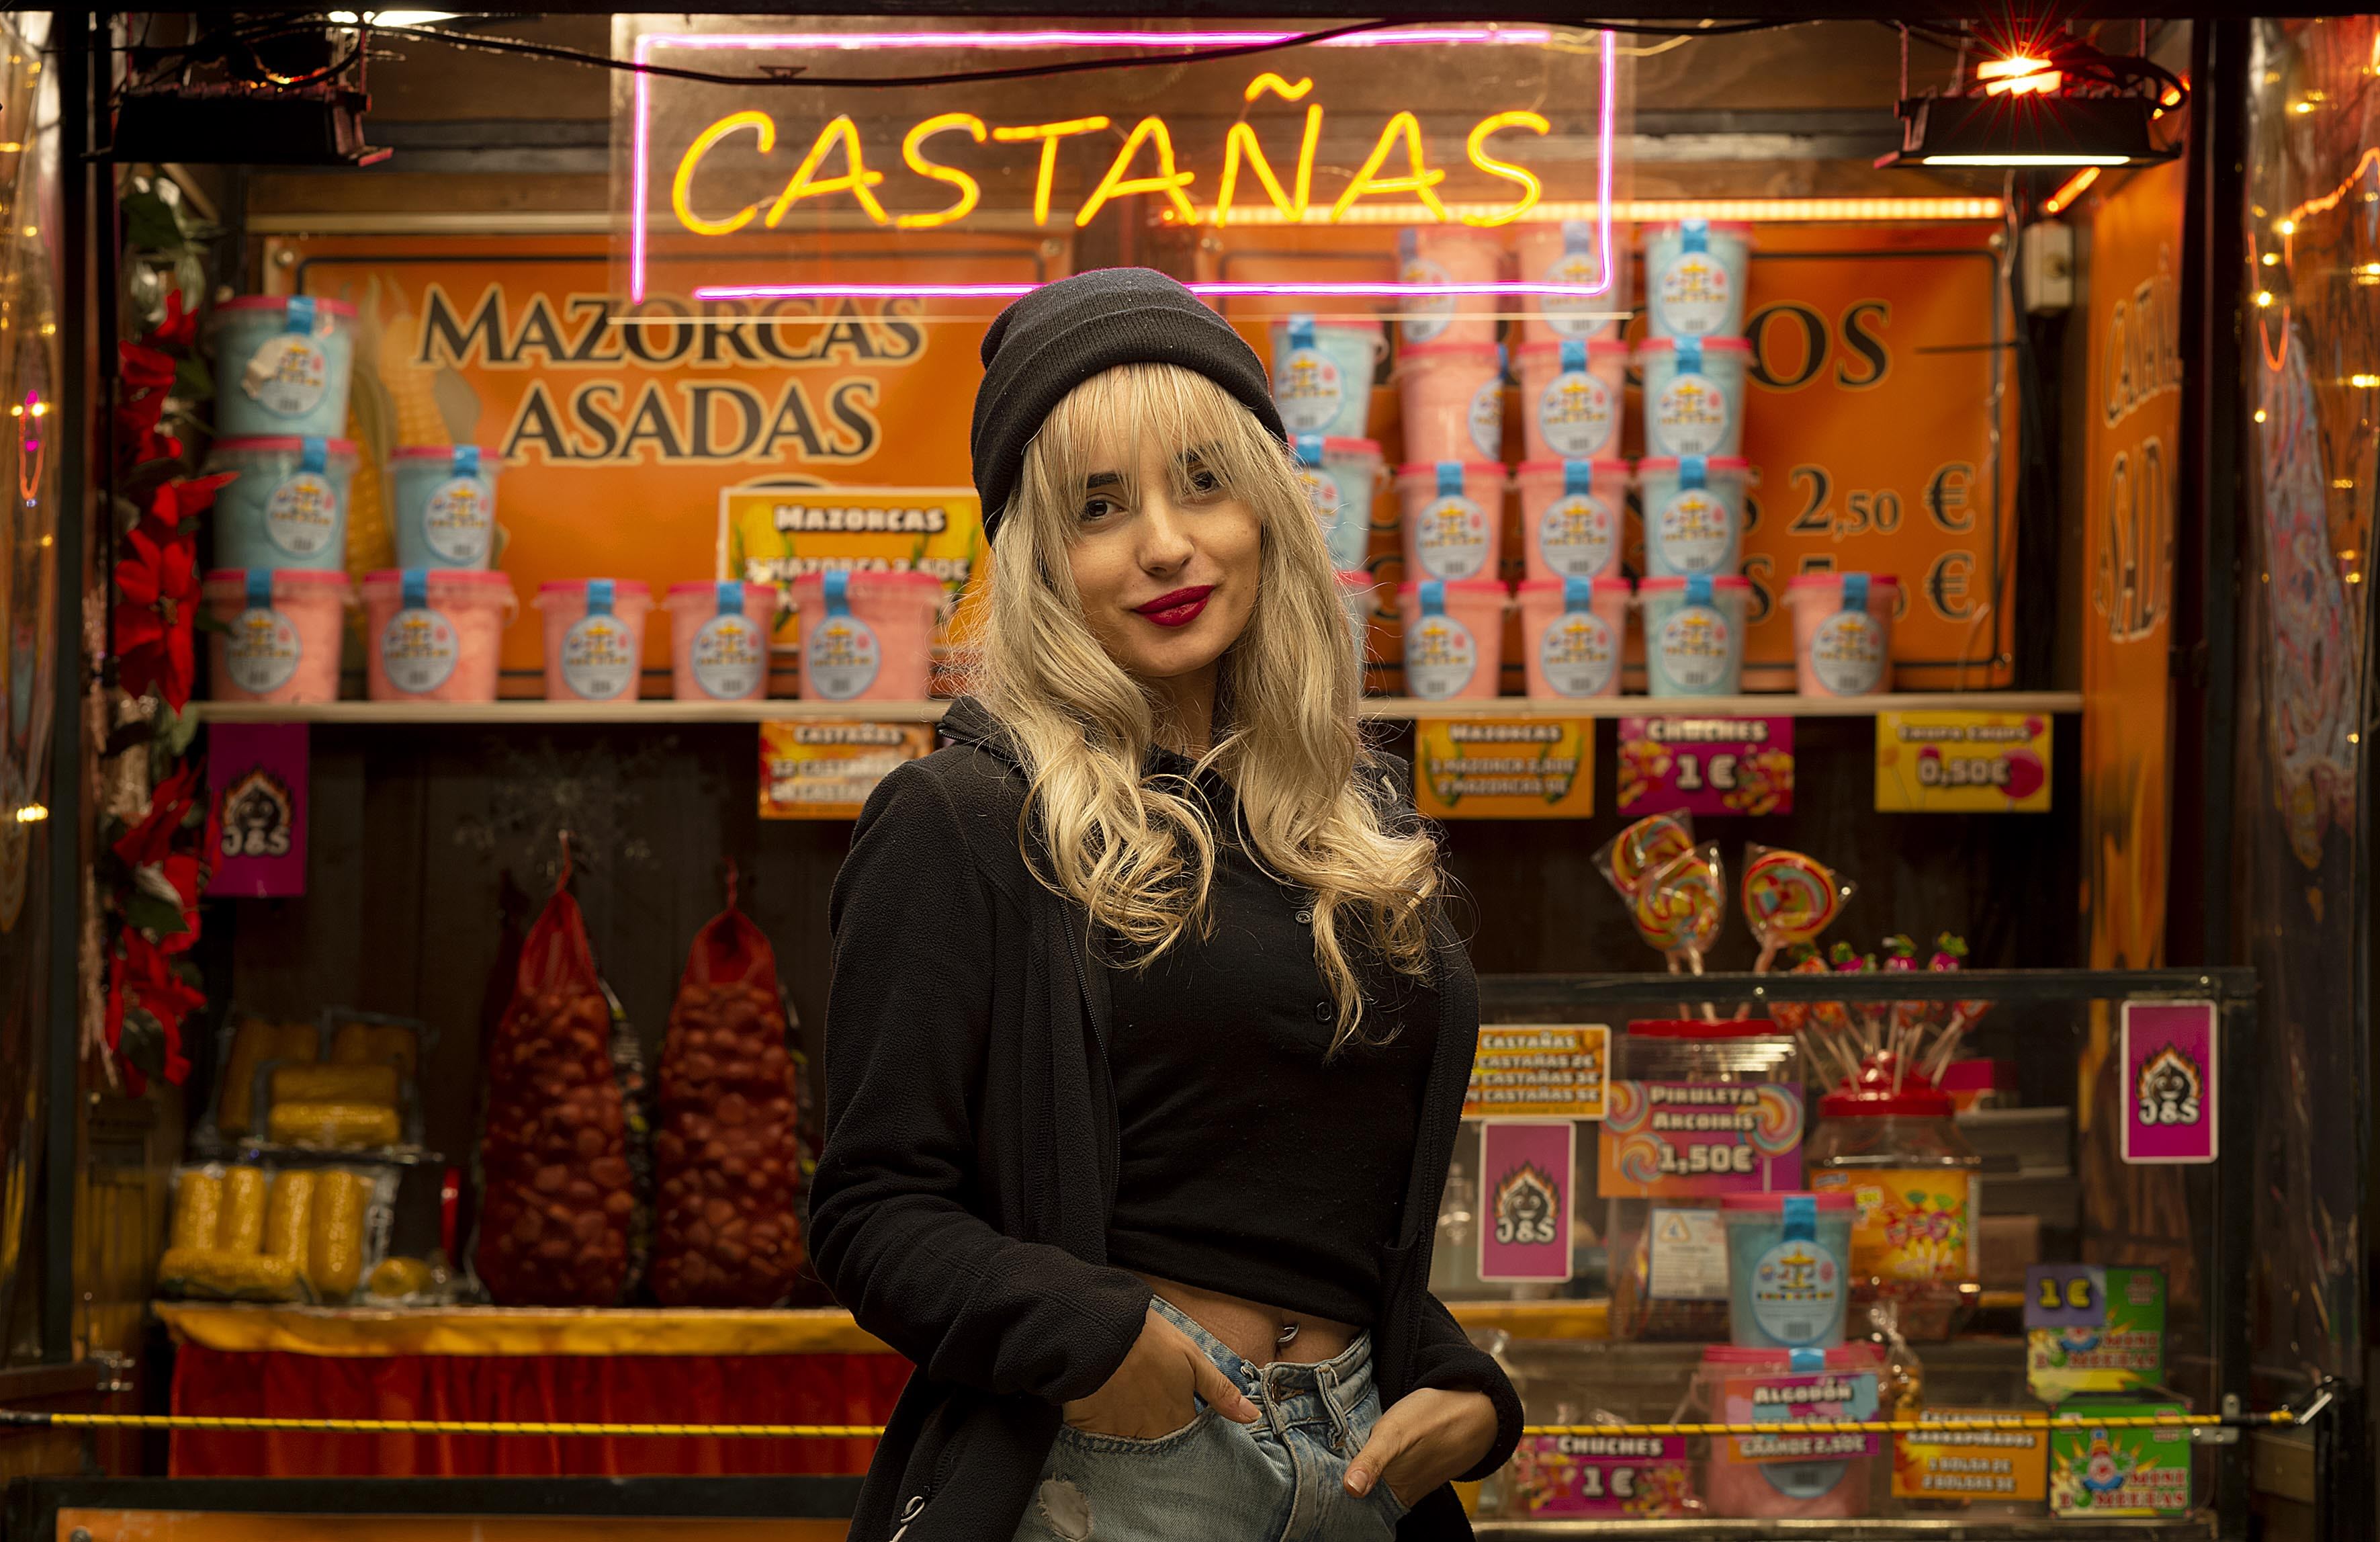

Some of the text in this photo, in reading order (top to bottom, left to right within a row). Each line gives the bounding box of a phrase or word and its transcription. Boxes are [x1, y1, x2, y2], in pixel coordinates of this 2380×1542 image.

[670, 72, 1551, 237] CASTAÑAS
[415, 282, 928, 370] MAZORCAS
[500, 378, 883, 465] ASADAS
[1921, 460, 1976, 535] €
[775, 504, 946, 533] MAZORCAS
[1922, 550, 1976, 624] €
[1449, 723, 1563, 742] MAZORCAS
[1647, 719, 1768, 743] CHUCHES
[1919, 758, 2011, 789] 0,50€
[221, 825, 291, 857] J&S
[1480, 1029, 1577, 1050] CASTAÑAS
[1478, 1053, 1570, 1069] CASTAÑAS
[1481, 1069, 1574, 1086] CASTAÑAS
[1482, 1086, 1575, 1103] CASTAÑAS
[1649, 1085, 1758, 1105] PIRULETA
[1652, 1111, 1755, 1131] ARCOIRIS
[2138, 1096, 2200, 1127] J&S
[1659, 1143, 1755, 1174] 1,50€
[1495, 1215, 1556, 1244] J&S
[1753, 1377, 1853, 1404] ALGODÓN
[1556, 1434, 1664, 1457] CHUCHES
